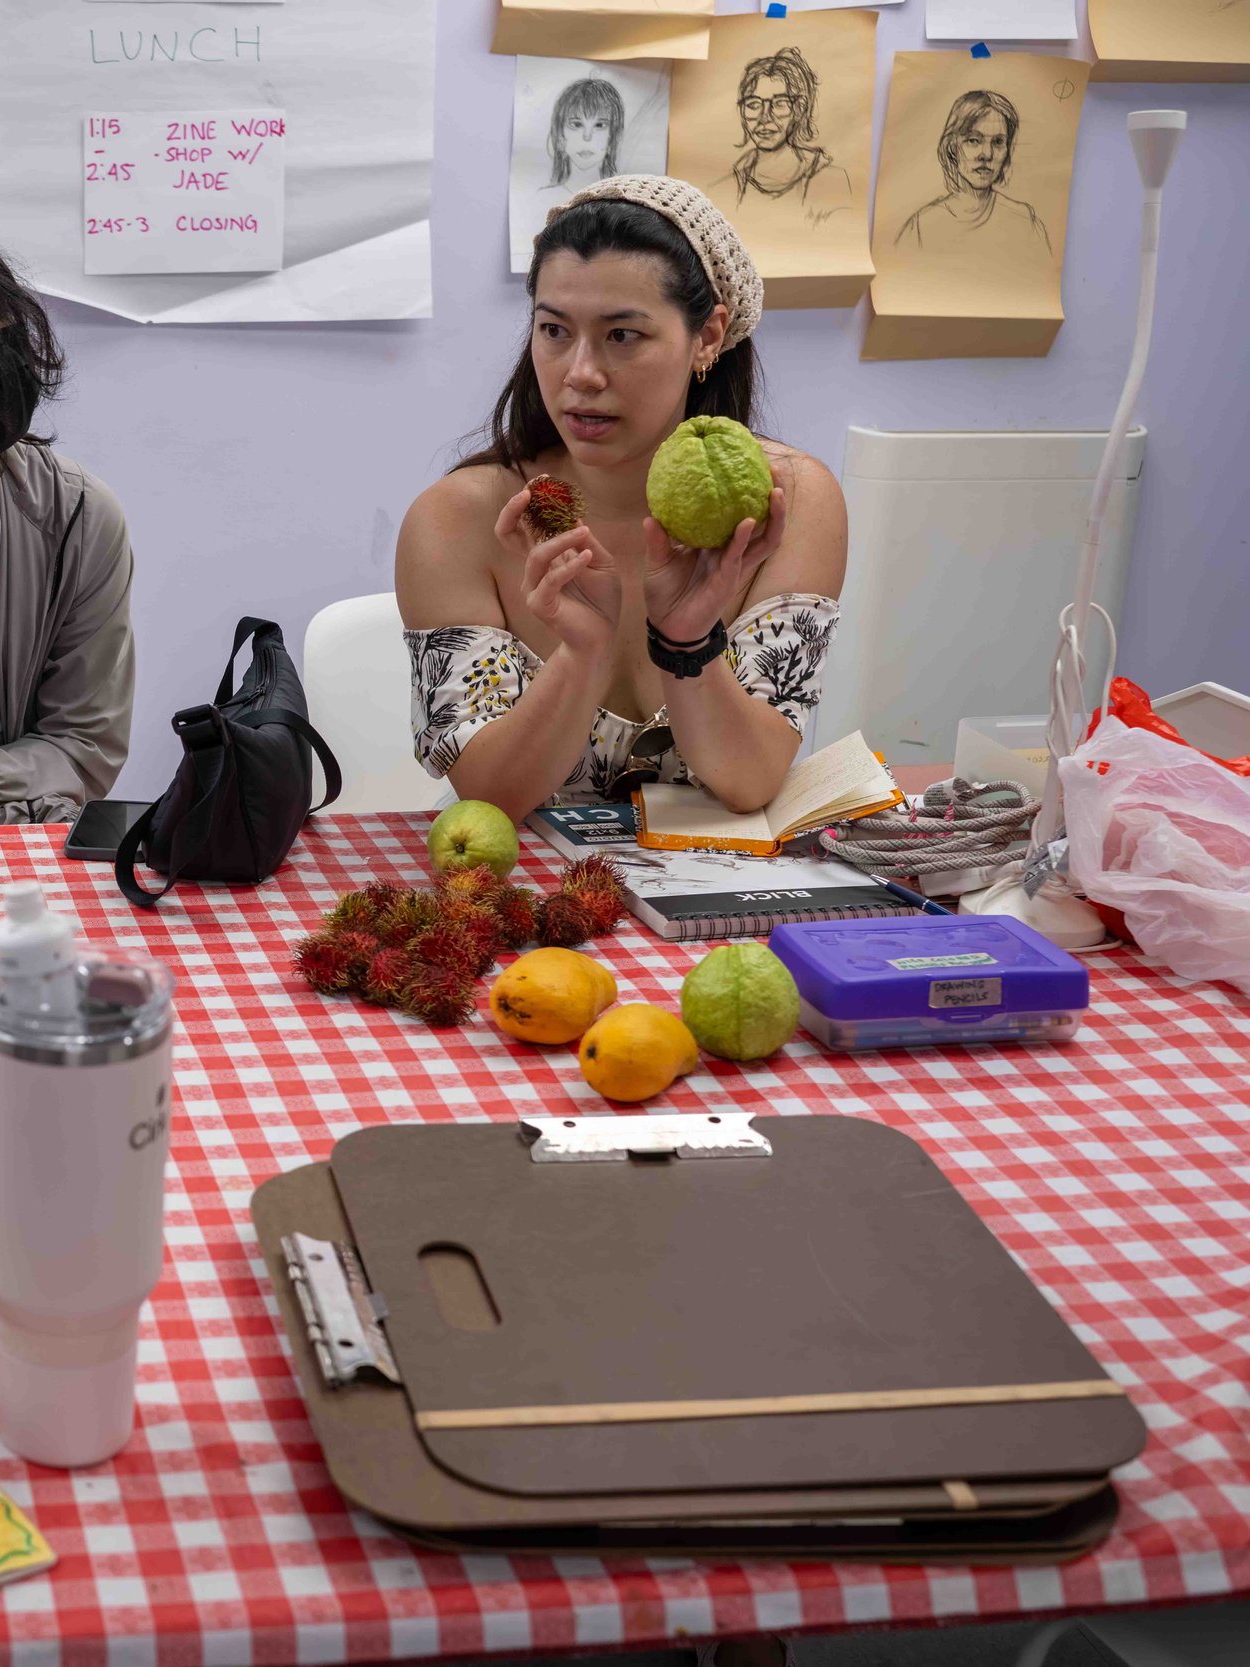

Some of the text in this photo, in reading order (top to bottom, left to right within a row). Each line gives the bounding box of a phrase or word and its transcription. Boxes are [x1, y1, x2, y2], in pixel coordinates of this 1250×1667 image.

[89, 26, 261, 64] LUNCH
[89, 117, 121, 138] 1:15
[166, 120, 217, 142] ZINE
[86, 162, 136, 181] 2:45
[173, 169, 230, 191] JADE
[175, 213, 258, 234] CLOSING
[734, 890, 813, 902] BLICK
